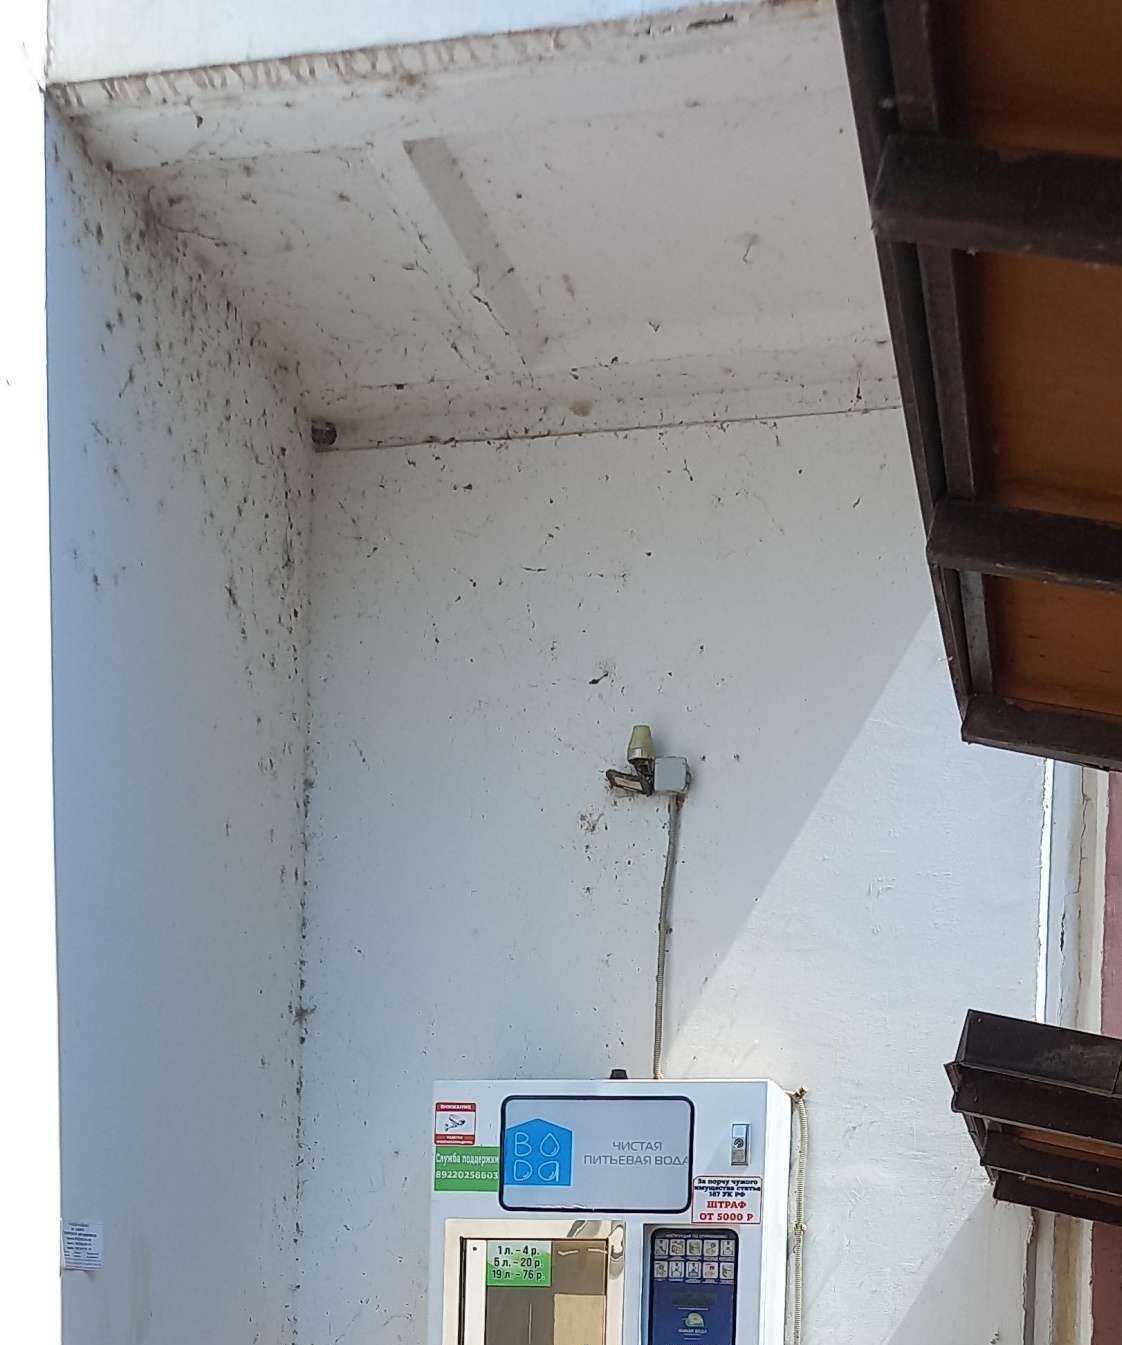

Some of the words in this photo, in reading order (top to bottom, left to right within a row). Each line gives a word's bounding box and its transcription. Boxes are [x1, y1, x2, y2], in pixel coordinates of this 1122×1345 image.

[612, 1141, 663, 1151] ЧИСТАЯ
[436, 1152, 461, 1166] Служба
[583, 1155, 652, 1165] ПИТЬЕВАЯ
[707, 1201, 747, 1209] ШТРАФ
[699, 1213, 714, 1221] ОТ
[717, 1213, 743, 1221] 5000
[746, 1213, 754, 1221] Р
[520, 1258, 532, 1267] 20
[492, 1269, 502, 1279] 19
[523, 1270, 534, 1279] 76
